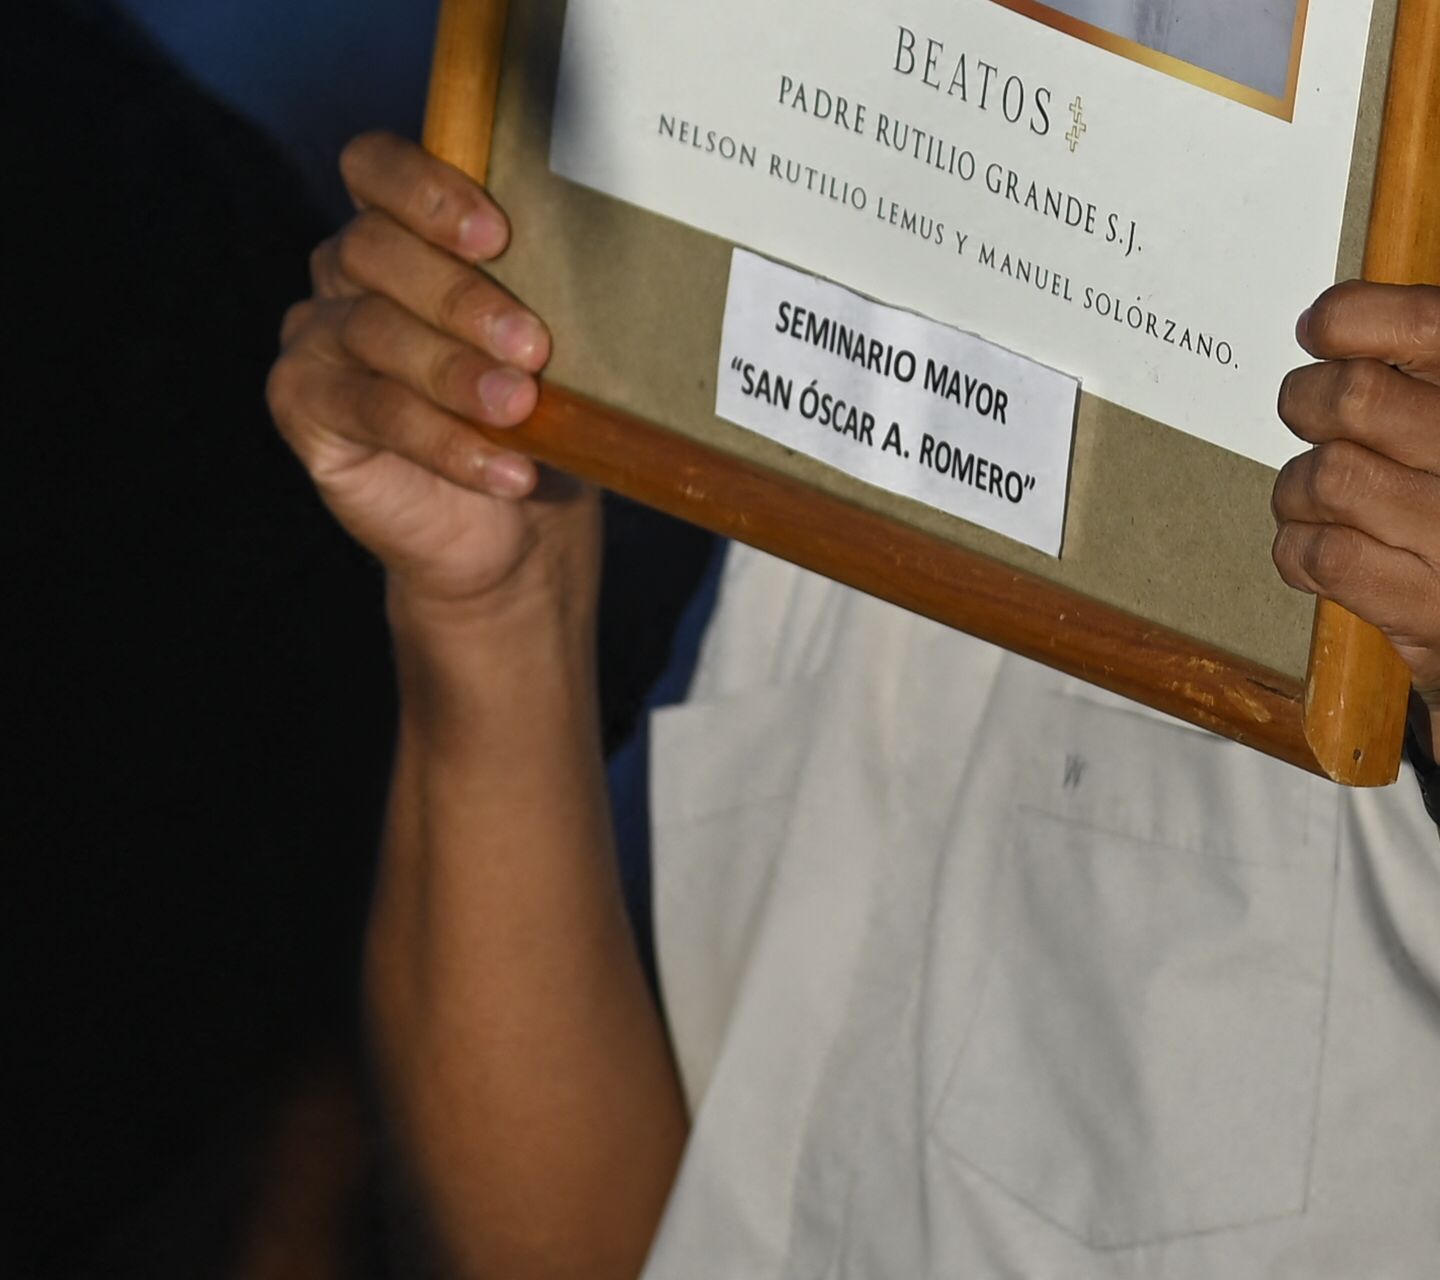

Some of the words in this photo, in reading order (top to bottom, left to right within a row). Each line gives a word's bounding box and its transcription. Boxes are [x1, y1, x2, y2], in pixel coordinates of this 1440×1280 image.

[892, 25, 1052, 136] BEATOS
[657, 113, 757, 168] NELSON
[768, 153, 867, 211] RUTILIO
[876, 196, 945, 246] LEMUS
[955, 230, 969, 256] Y
[978, 242, 1073, 303] MANUEL
[778, 74, 867, 135] PADRE
[875, 112, 976, 182] RUTILIO
[985, 162, 1097, 235] GRANDE
[1105, 212, 1142, 257] S.J.
[730, 355, 794, 412] “SAN
[798, 378, 876, 448] ÓSCAR
[880, 421, 910, 460] A.
[918, 432, 1036, 505] ROMERO”
[774, 300, 917, 384] SEMINARIO
[923, 357, 1009, 426] MAYOR
